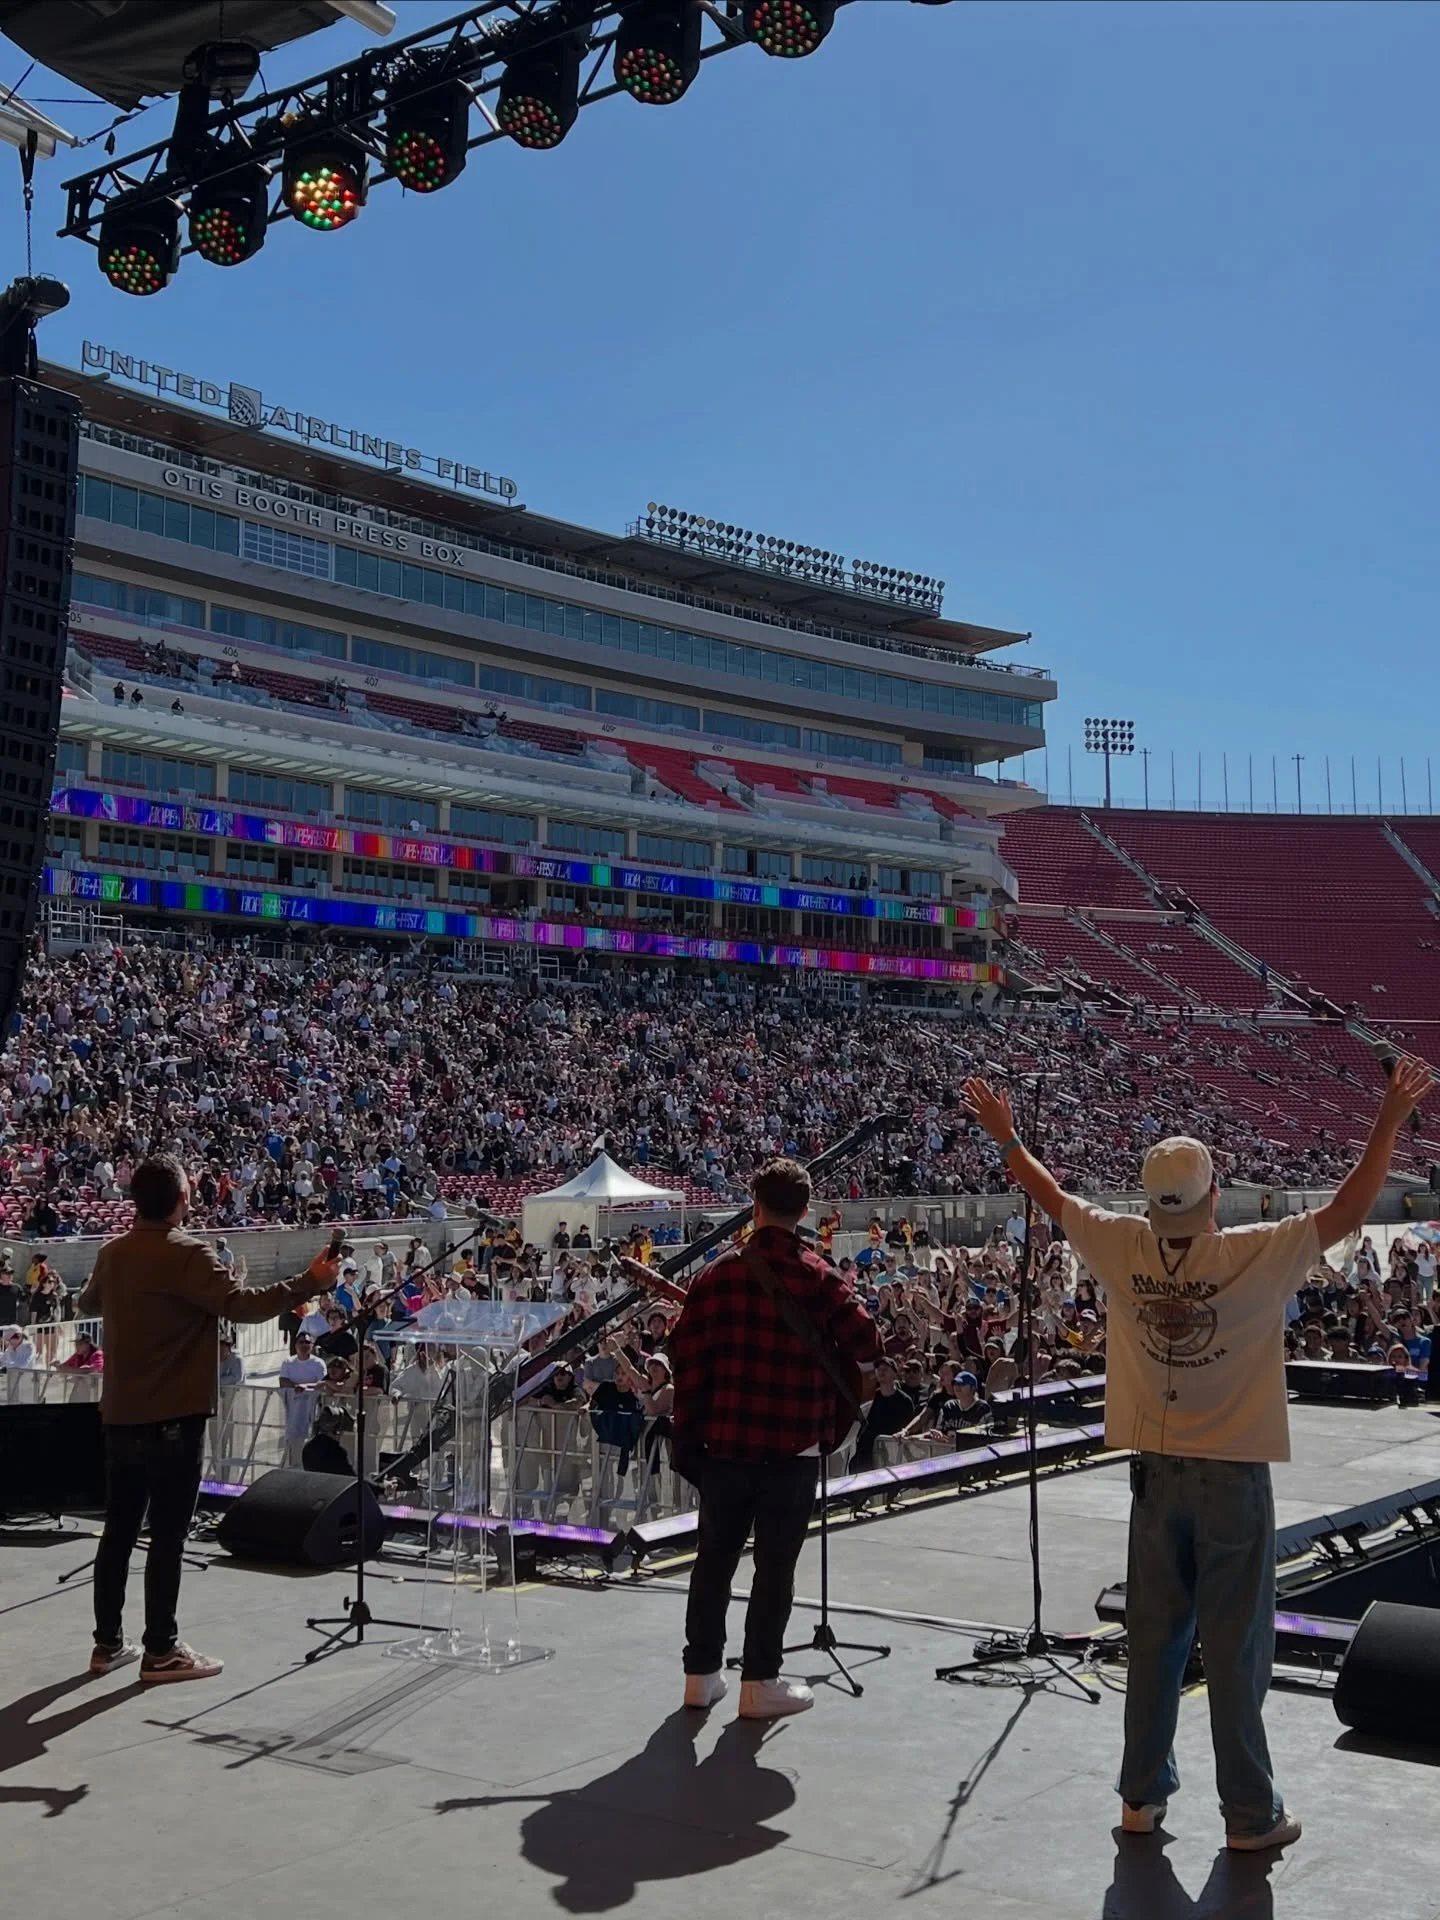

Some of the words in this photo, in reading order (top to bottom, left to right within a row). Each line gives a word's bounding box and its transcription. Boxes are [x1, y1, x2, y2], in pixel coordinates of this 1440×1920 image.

[83, 340, 221, 406] UNITED
[269, 406, 422, 470] AIRLINES
[438, 457, 518, 499] FIELD
[163, 469, 223, 499] OTIS
[236, 488, 323, 527] BOOTH
[335, 517, 408, 551] PRESS
[421, 541, 465, 567] BOX
[69, 611, 82, 624] 05
[222, 646, 239, 658] 406
[364, 676, 379, 688] 407
[1132, 1274, 1218, 1296] HANNUM'S
